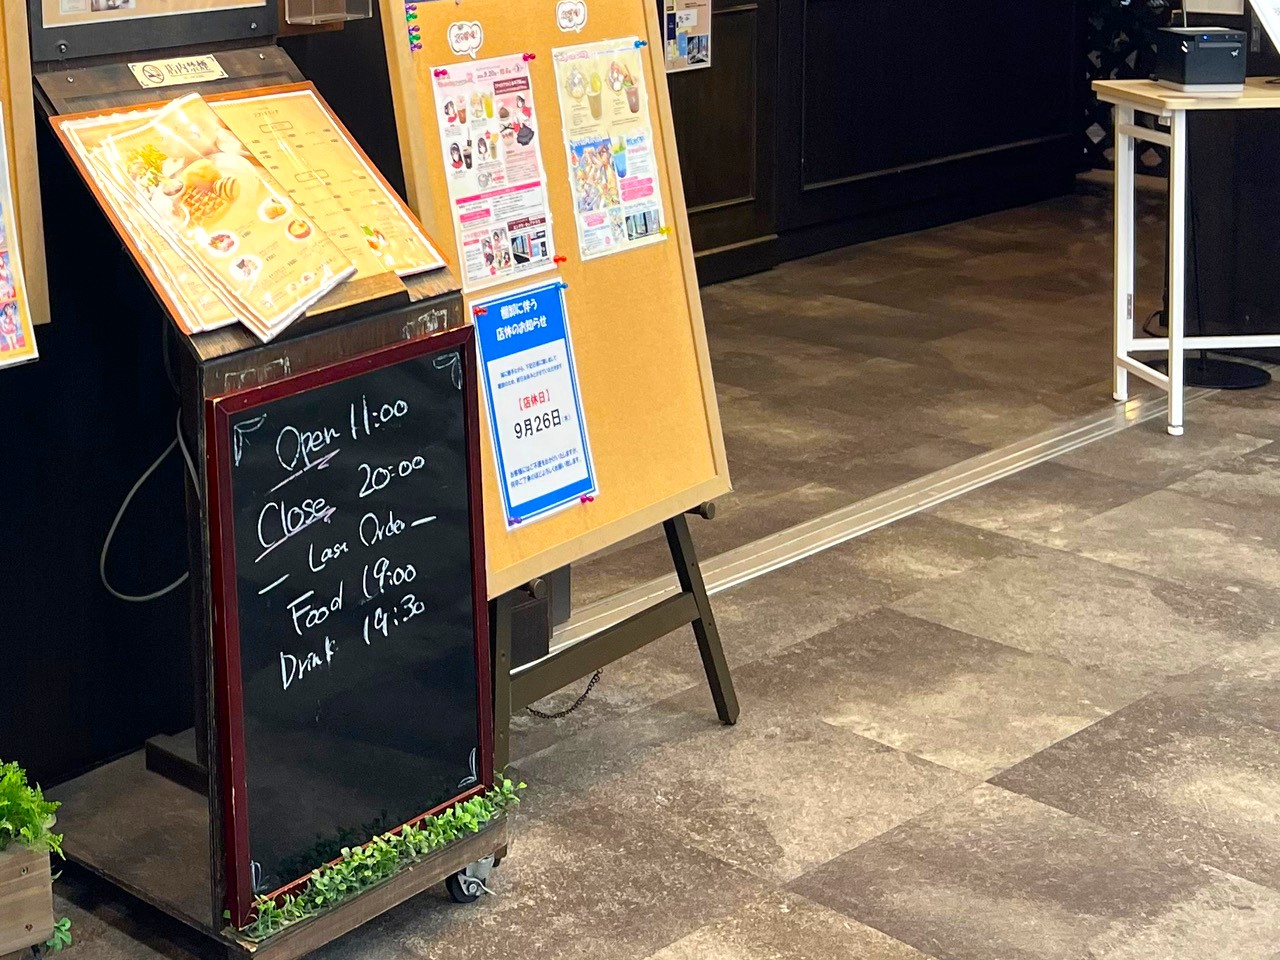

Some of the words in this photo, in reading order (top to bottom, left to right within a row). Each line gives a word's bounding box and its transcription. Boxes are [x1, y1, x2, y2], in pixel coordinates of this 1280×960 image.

[495, 314, 548, 342] 店休のお知らせ
[275, 425, 341, 472] Open
[350, 394, 409, 438] 11:00
[256, 495, 328, 550] Close
[358, 455, 426, 498] 20:00
[287, 580, 343, 636] Food
[361, 558, 417, 602] 19:00
[279, 635, 336, 691] Drink
[363, 598, 426, 646] 19:30
